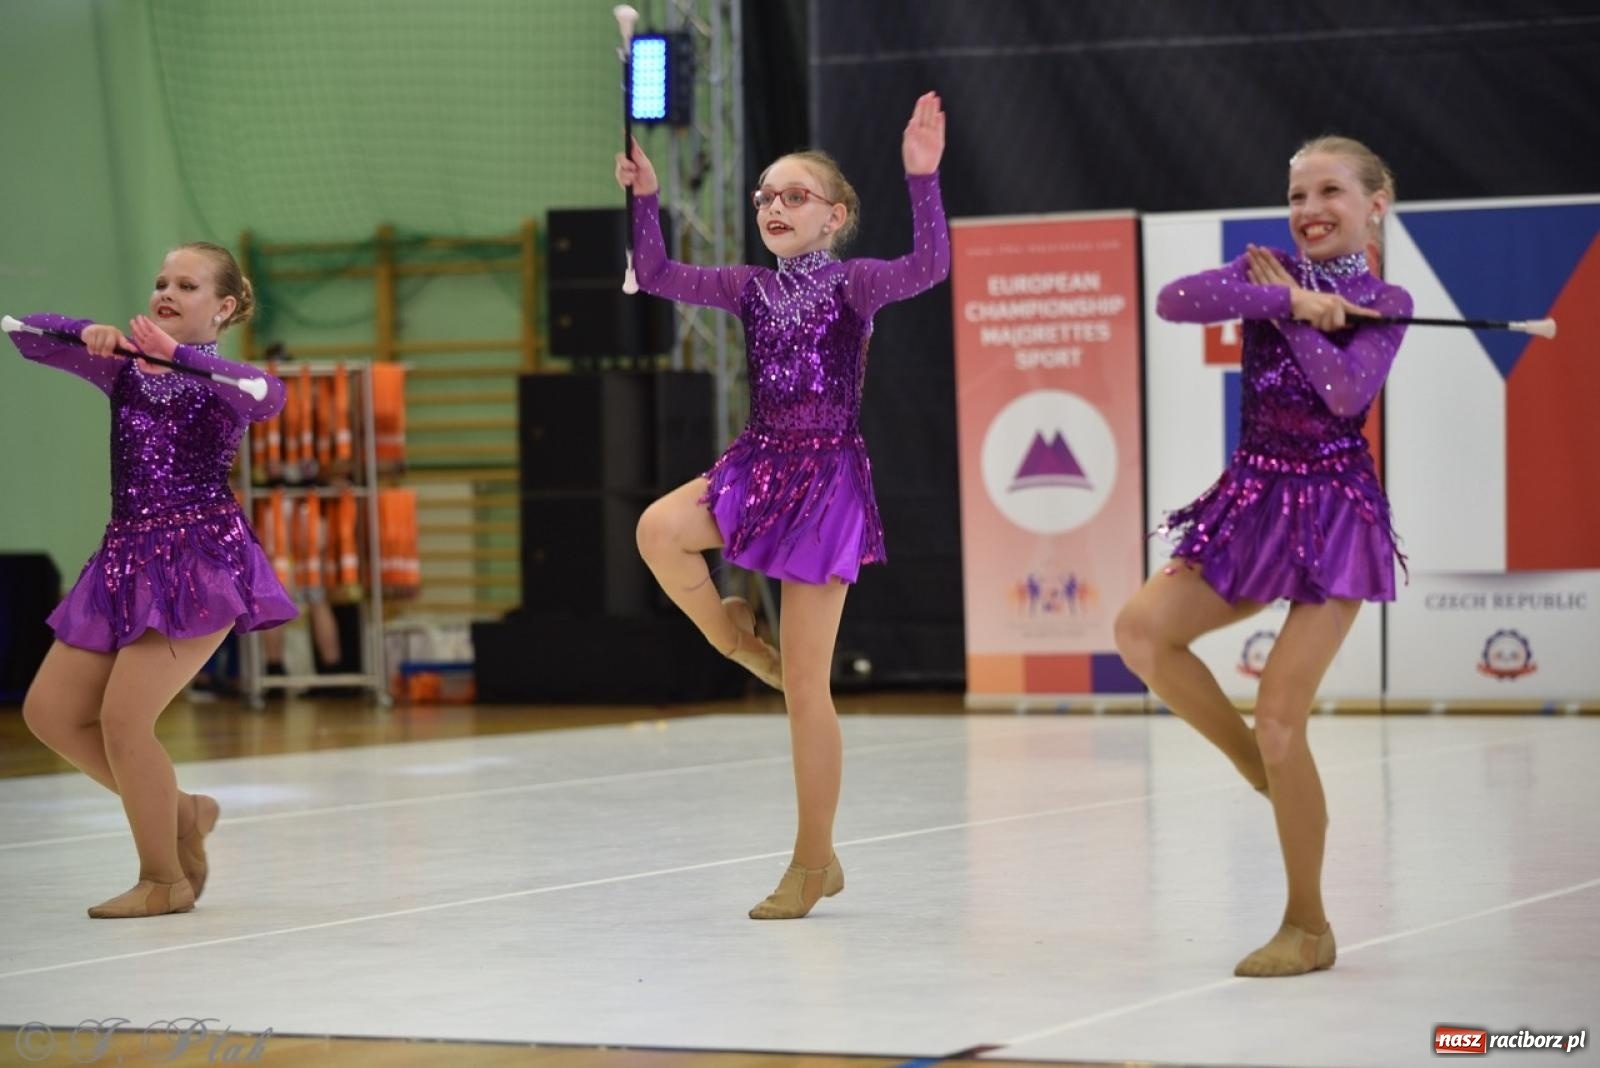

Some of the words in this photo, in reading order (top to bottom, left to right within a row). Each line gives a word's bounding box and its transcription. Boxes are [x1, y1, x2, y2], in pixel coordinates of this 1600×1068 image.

[987, 272, 1100, 296] EUROPEAN
[964, 294, 1126, 322] CHAMPIONSHIP
[980, 321, 1111, 348] MAJORETTES
[1014, 347, 1082, 371] SPORT
[1424, 592, 1486, 610] CZECH
[1493, 592, 1588, 610] REPUBLIC
